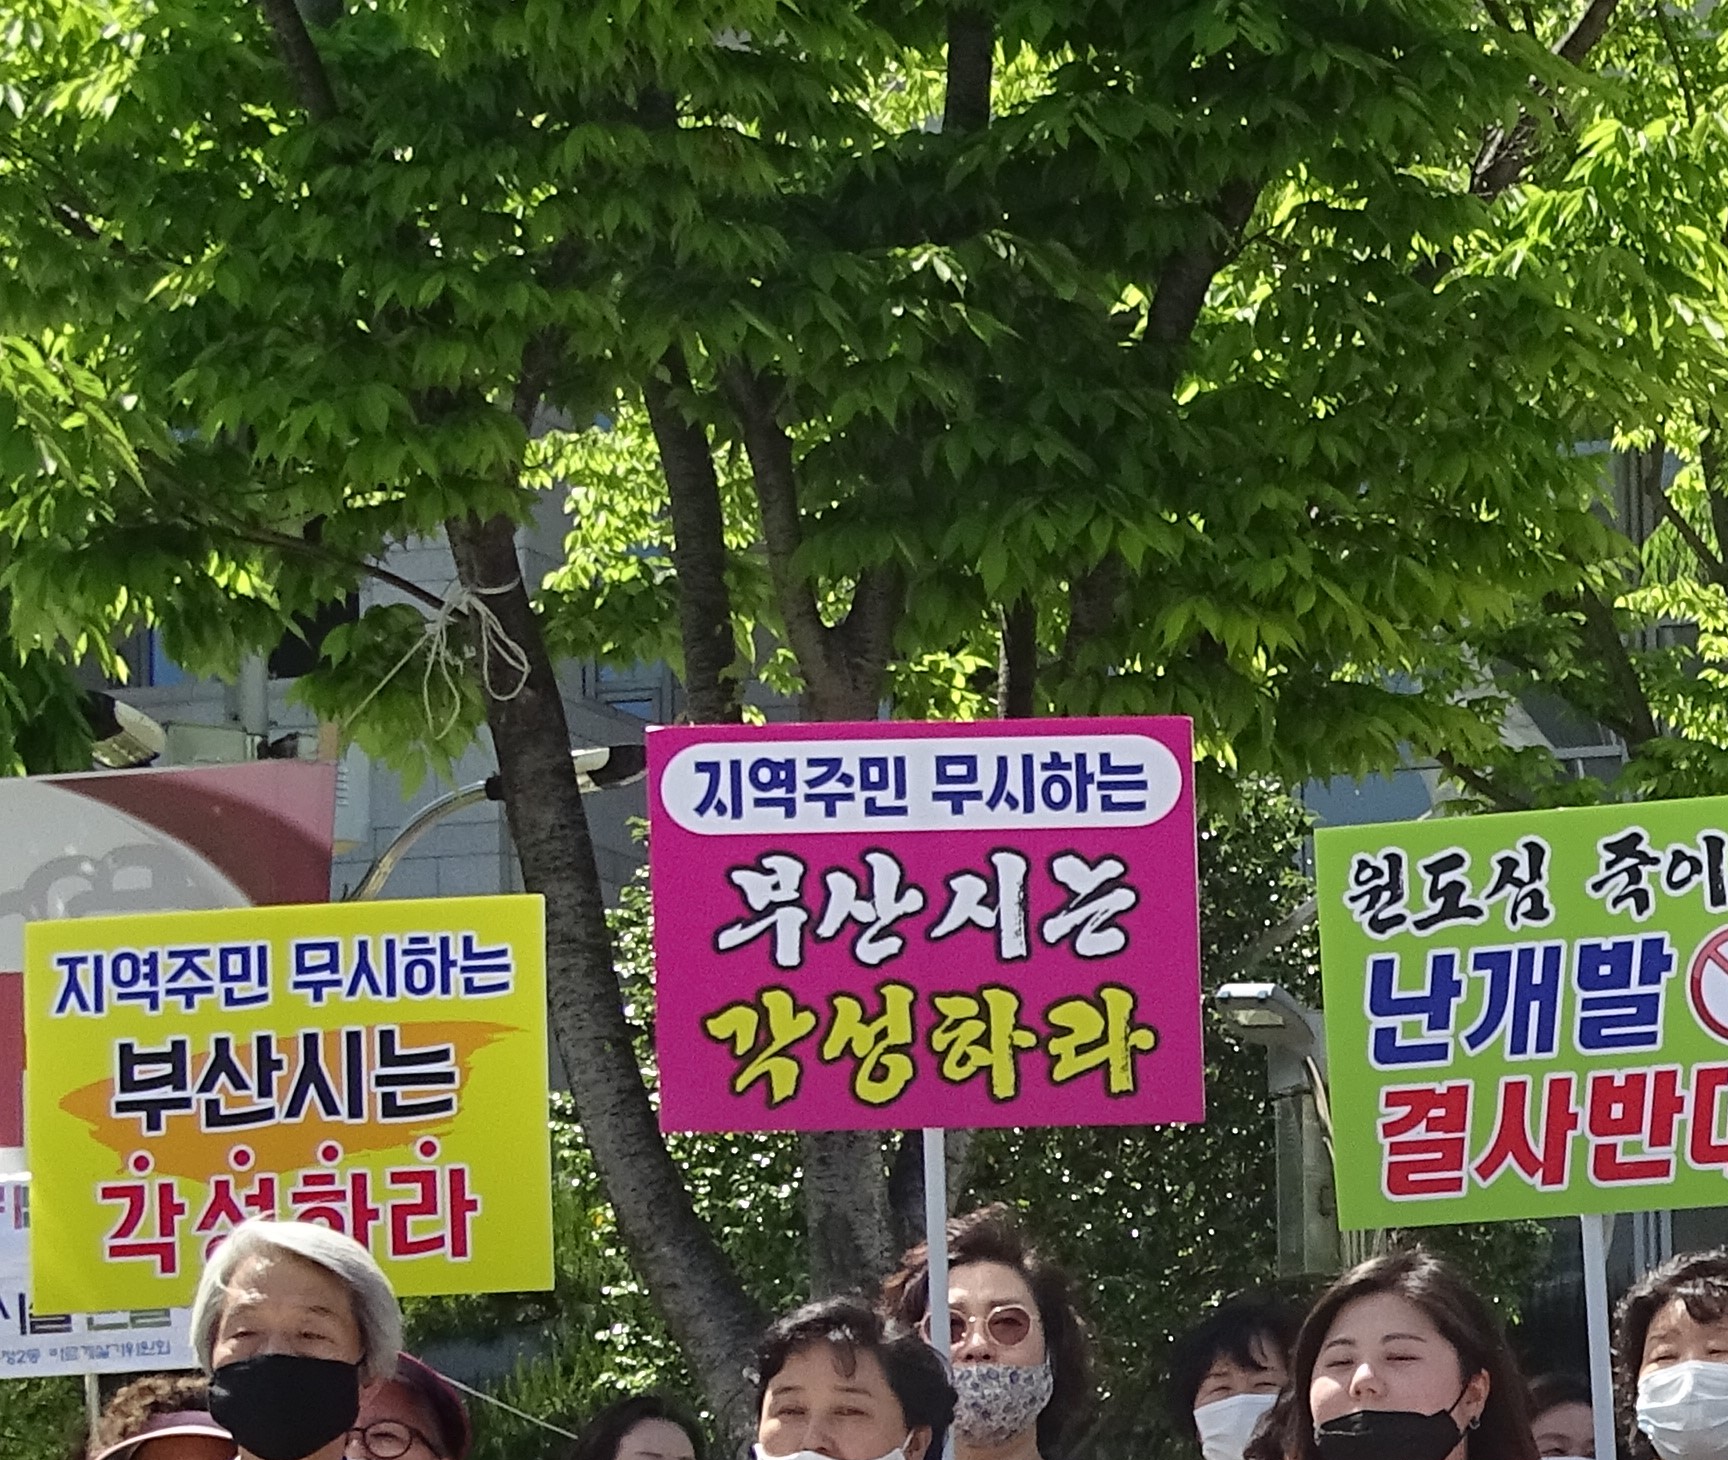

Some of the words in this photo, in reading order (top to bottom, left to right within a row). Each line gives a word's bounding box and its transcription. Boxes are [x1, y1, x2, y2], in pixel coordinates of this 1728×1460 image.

[694, 756, 909, 820] 지역주민
[931, 750, 1148, 815] 무시하는
[715, 849, 1139, 968] 부산시는
[1345, 841, 1552, 937] 원도심
[53, 943, 270, 1016] 지역주민
[290, 932, 513, 1003] 무시하는
[1367, 936, 1673, 1067] 난개발
[112, 1026, 457, 1135] 부산시는
[703, 983, 1158, 1105] 각성하라
